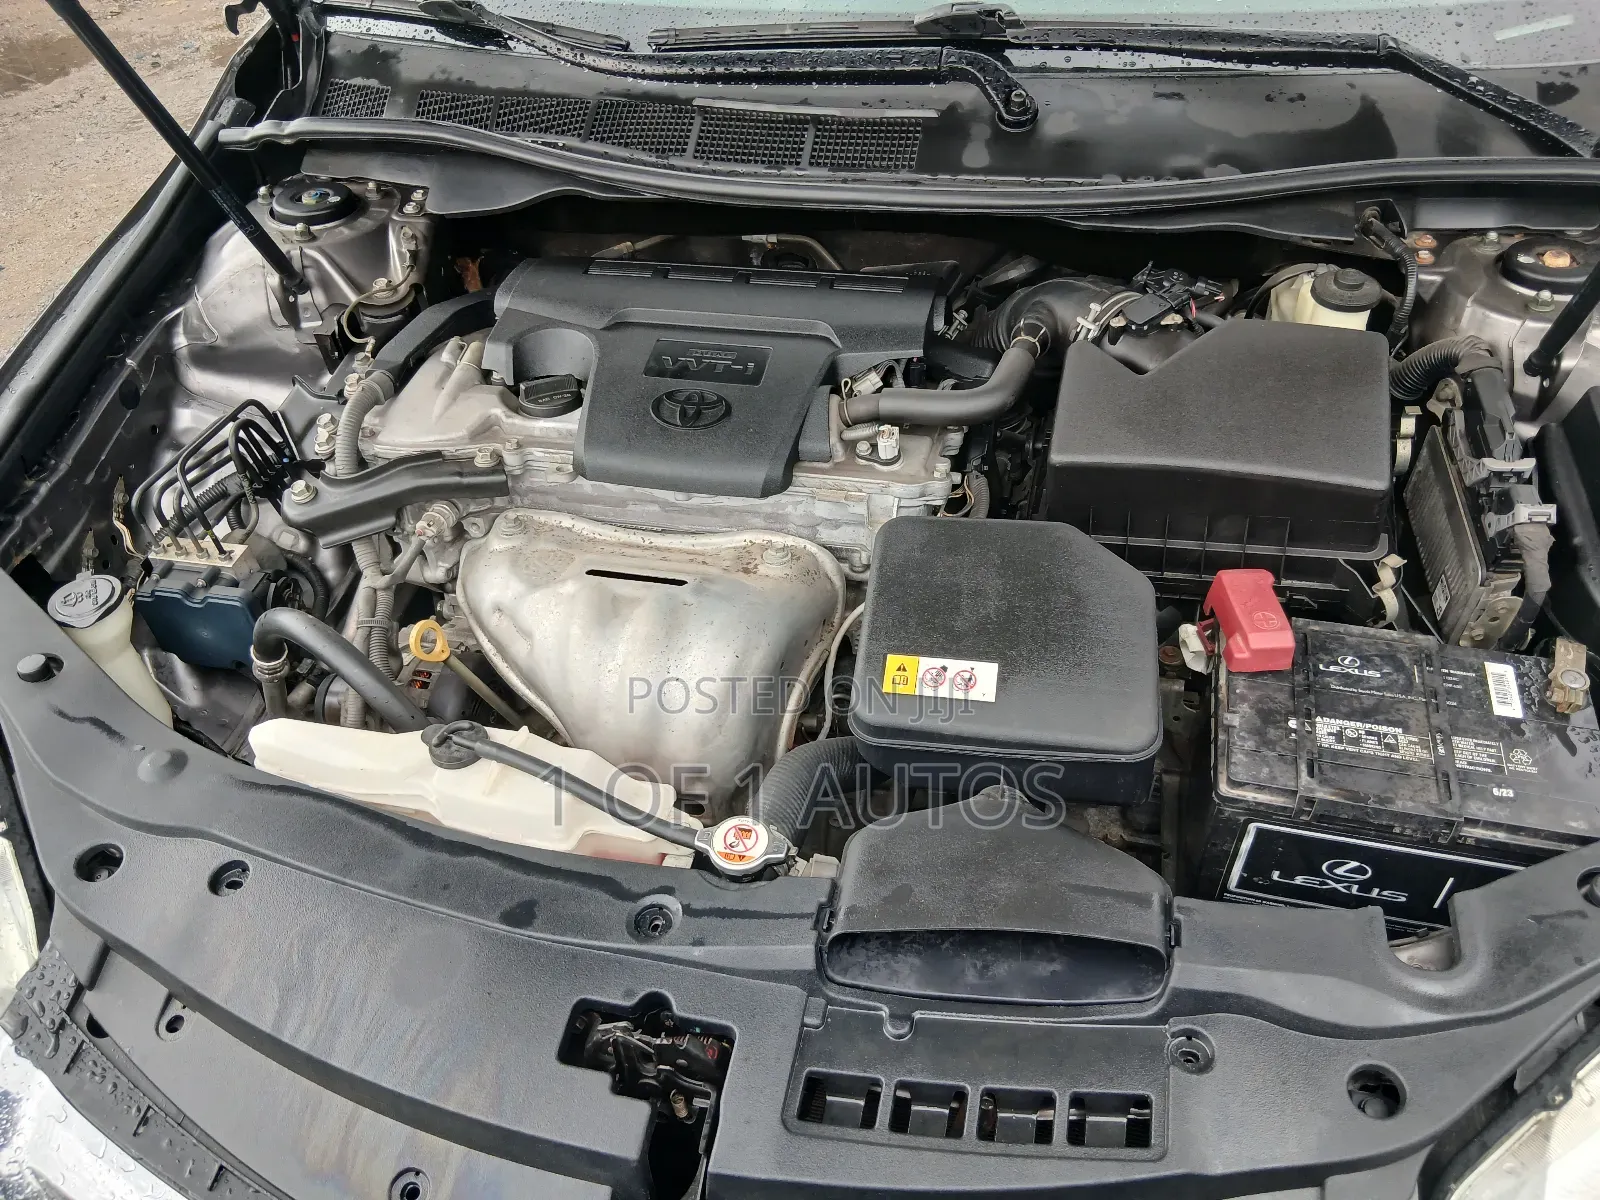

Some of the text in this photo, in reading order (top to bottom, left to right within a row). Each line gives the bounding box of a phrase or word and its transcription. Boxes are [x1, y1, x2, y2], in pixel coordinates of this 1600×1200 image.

[1318, 663, 1382, 679] LEXUS
[1322, 717, 1403, 734] DANGER/POISON
[1492, 787, 1514, 798] 6/23
[1270, 869, 1408, 903] LEXUS
